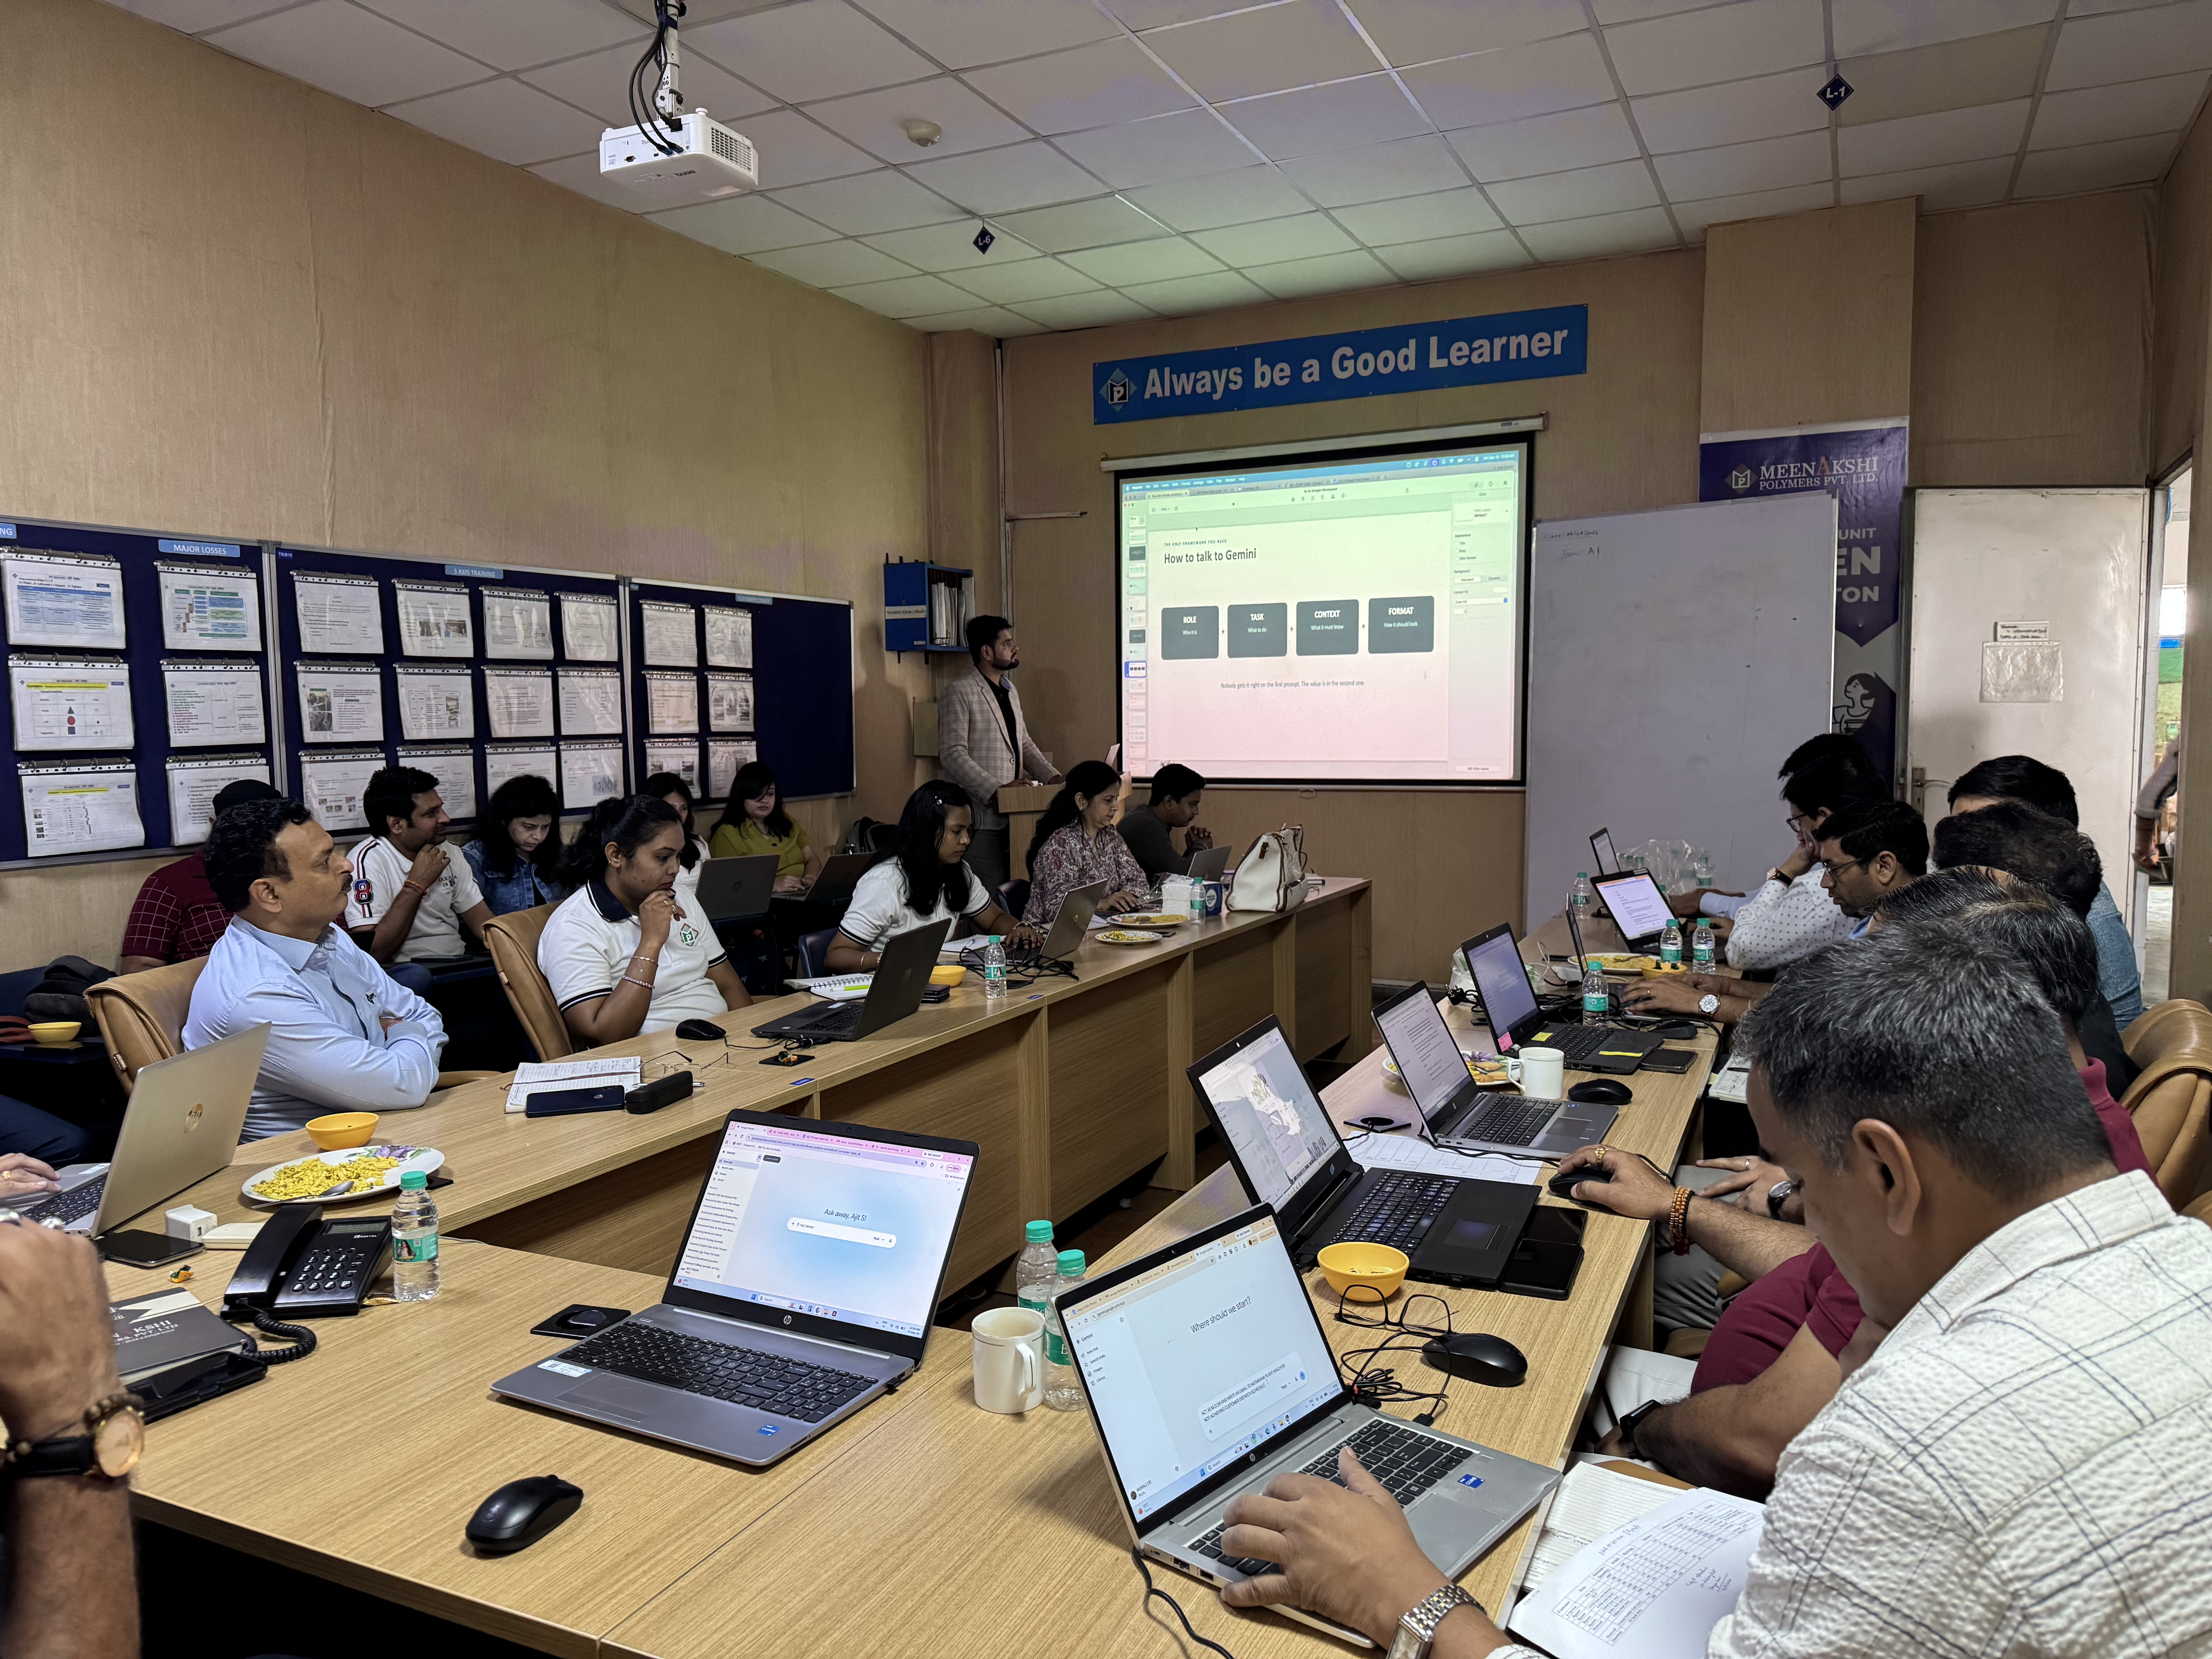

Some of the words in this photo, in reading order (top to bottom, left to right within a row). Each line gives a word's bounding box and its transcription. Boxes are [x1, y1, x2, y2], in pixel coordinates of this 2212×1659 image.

[1826, 86, 1845, 98] L-1
[979, 235, 990, 246] L-6
[1144, 366, 1243, 401] Always
[1254, 357, 1291, 389] be
[1301, 358, 1321, 383] a
[1332, 338, 1416, 379] Good
[1429, 328, 1569, 368] Learner
[1760, 456, 1878, 480] MEENAKSHI
[1759, 477, 1820, 490] POLYMERS
[1824, 476, 1848, 486] PVT.
[1853, 473, 1878, 484] LTD.
[1839, 528, 1876, 539] UNIT
[174, 544, 199, 553] MAJOR
[1164, 553, 1183, 563] How
[1186, 553, 1194, 562] to
[1197, 551, 1212, 562] talk
[1215, 551, 1223, 561] to
[1226, 548, 1256, 560] Gemini
[1836, 586, 1879, 603] ON
[1389, 607, 1414, 615] FORMAT
[353, 879, 373, 905] 8
[1190, 1320, 1209, 1333] Where
[1210, 1309, 1228, 1324] should
[1236, 1297, 1251, 1310] start?
